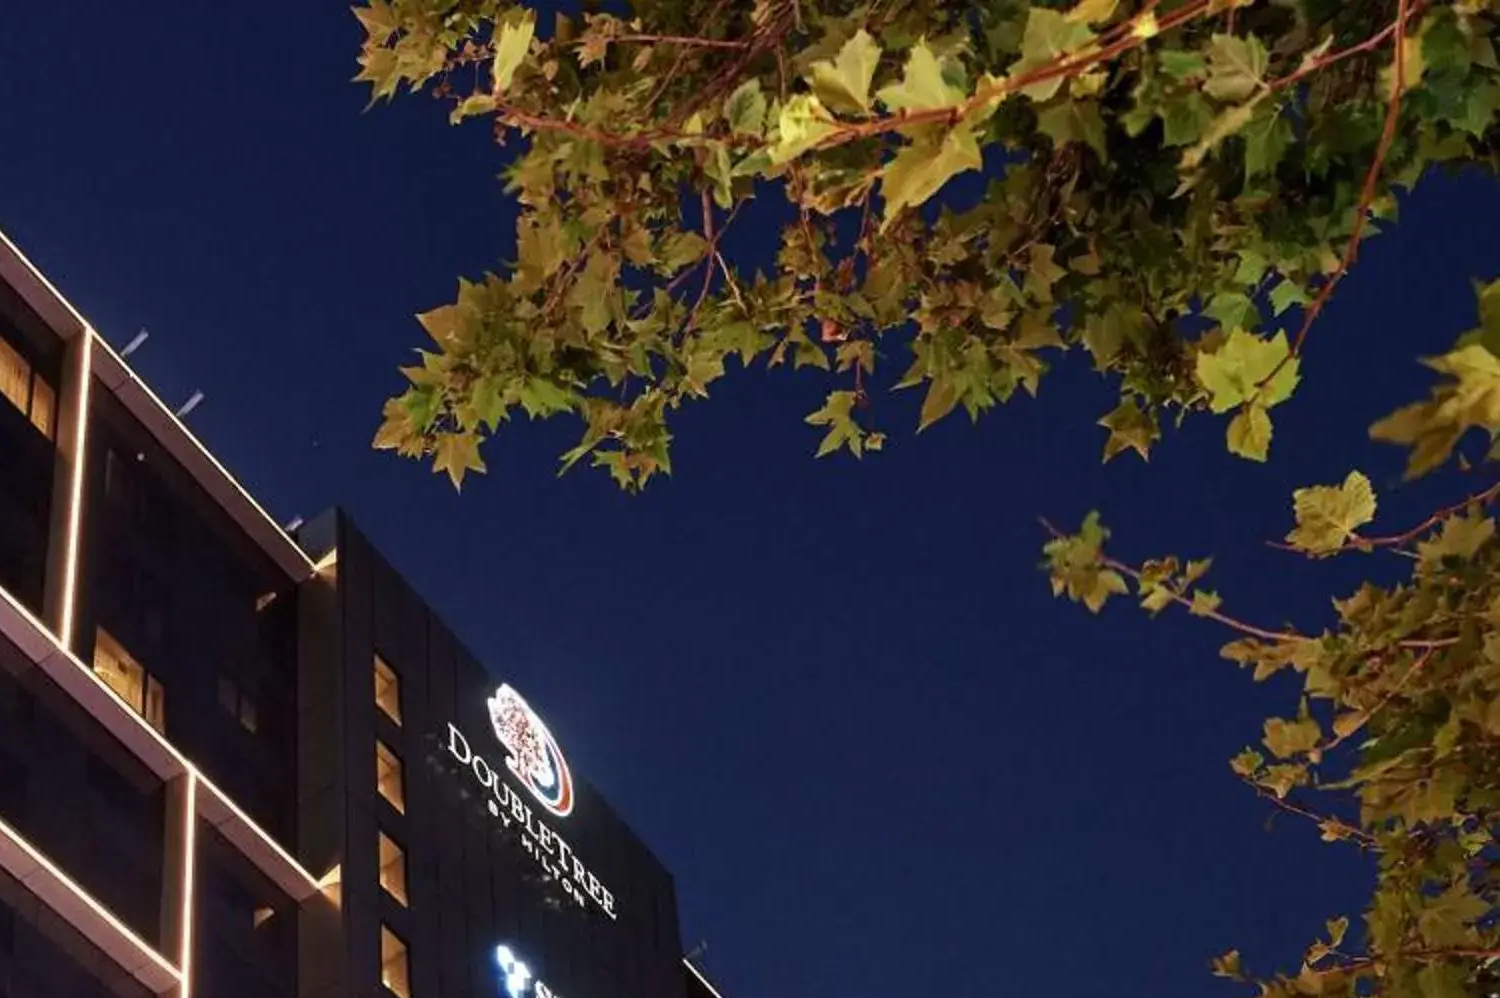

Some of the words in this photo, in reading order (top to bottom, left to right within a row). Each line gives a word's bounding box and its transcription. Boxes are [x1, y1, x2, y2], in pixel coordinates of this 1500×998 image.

[447, 721, 617, 920] DOUBLETREE
[488, 800, 511, 827] BY
[522, 834, 585, 907] HILTON
